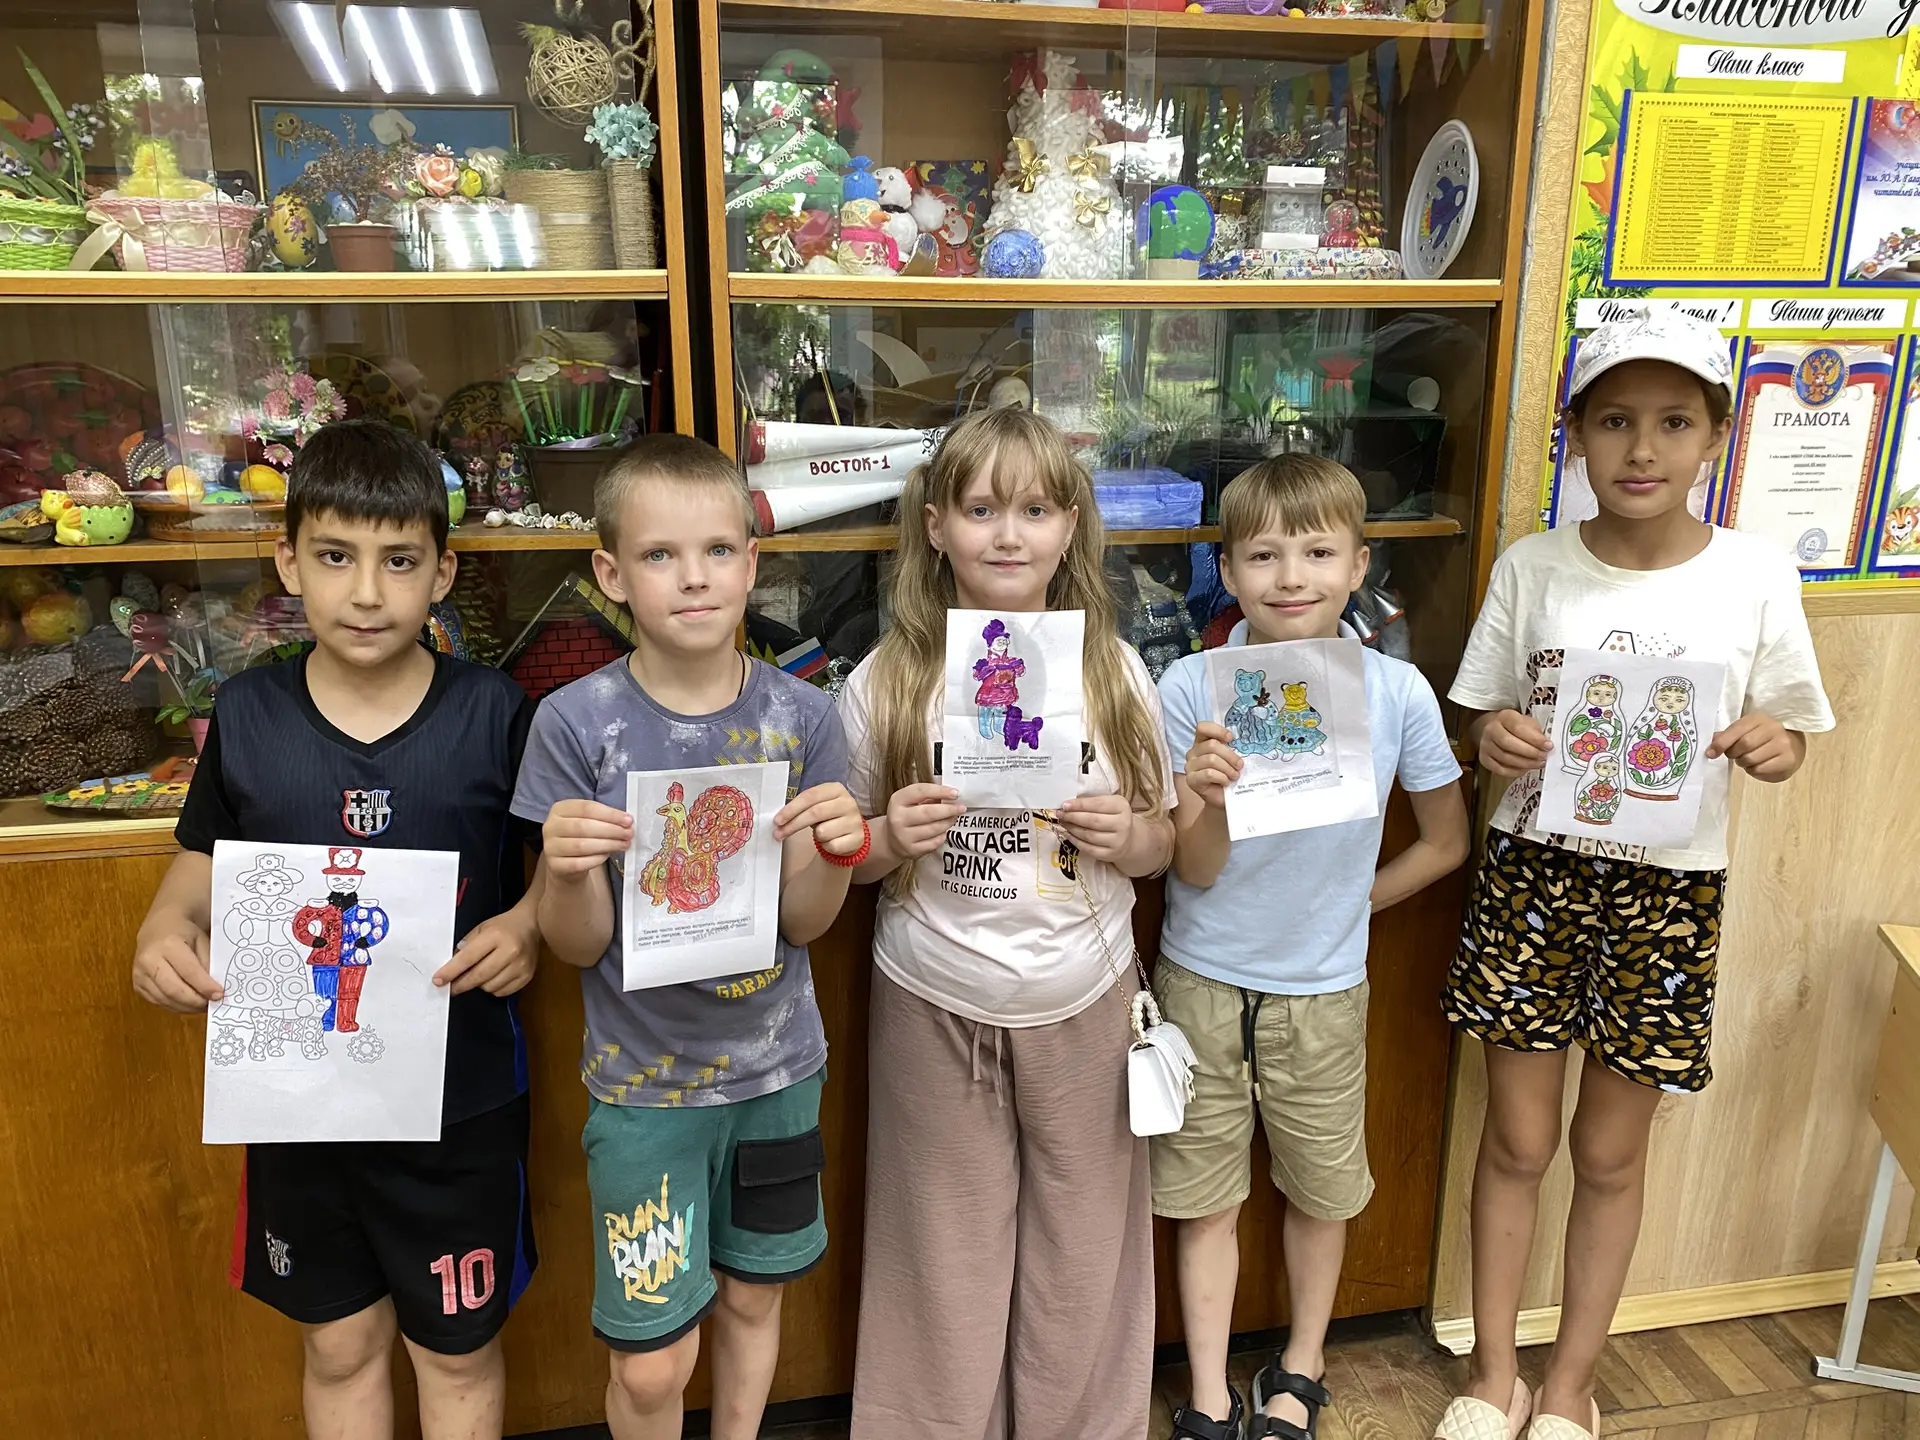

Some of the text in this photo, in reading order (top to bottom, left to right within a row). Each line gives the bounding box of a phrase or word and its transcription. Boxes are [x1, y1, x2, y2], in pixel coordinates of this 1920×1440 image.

[1706, 49, 1805, 76] Наш класс
[1769, 299, 1886, 331] Наши успехи
[1773, 412, 1851, 427] ГРАМОТА
[809, 455, 891, 475] ВОСТОК-1
[943, 851, 1003, 882] DRINK
[941, 879, 1018, 900] IT IS DELICIOUS
[604, 1172, 670, 1260] RUN
[430, 1247, 496, 1315] 10
